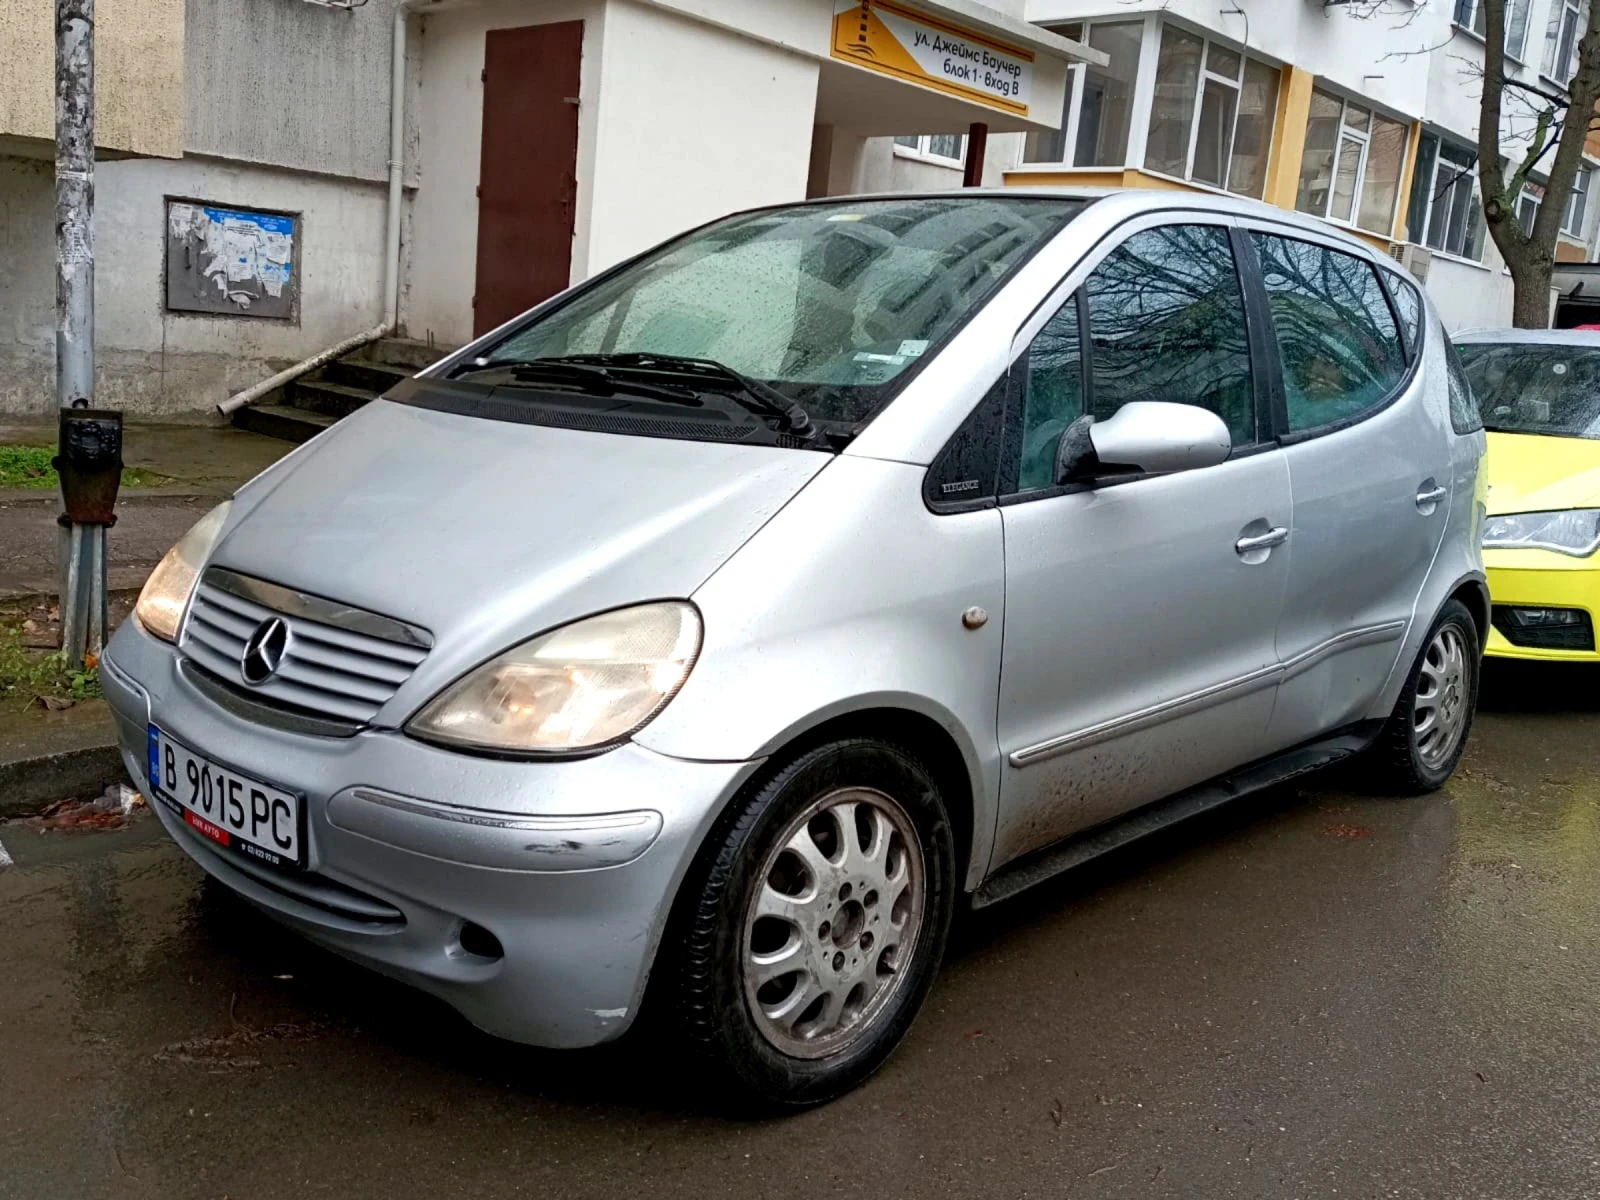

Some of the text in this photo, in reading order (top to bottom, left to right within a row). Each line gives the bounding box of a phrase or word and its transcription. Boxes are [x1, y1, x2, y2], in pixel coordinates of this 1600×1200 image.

[914, 31, 1021, 79] ул. Джеймс Баучер
[943, 58, 1019, 96] блок 1 вход В
[165, 743, 177, 791] B
[186, 759, 245, 829] 9015
[250, 788, 292, 850] PC
